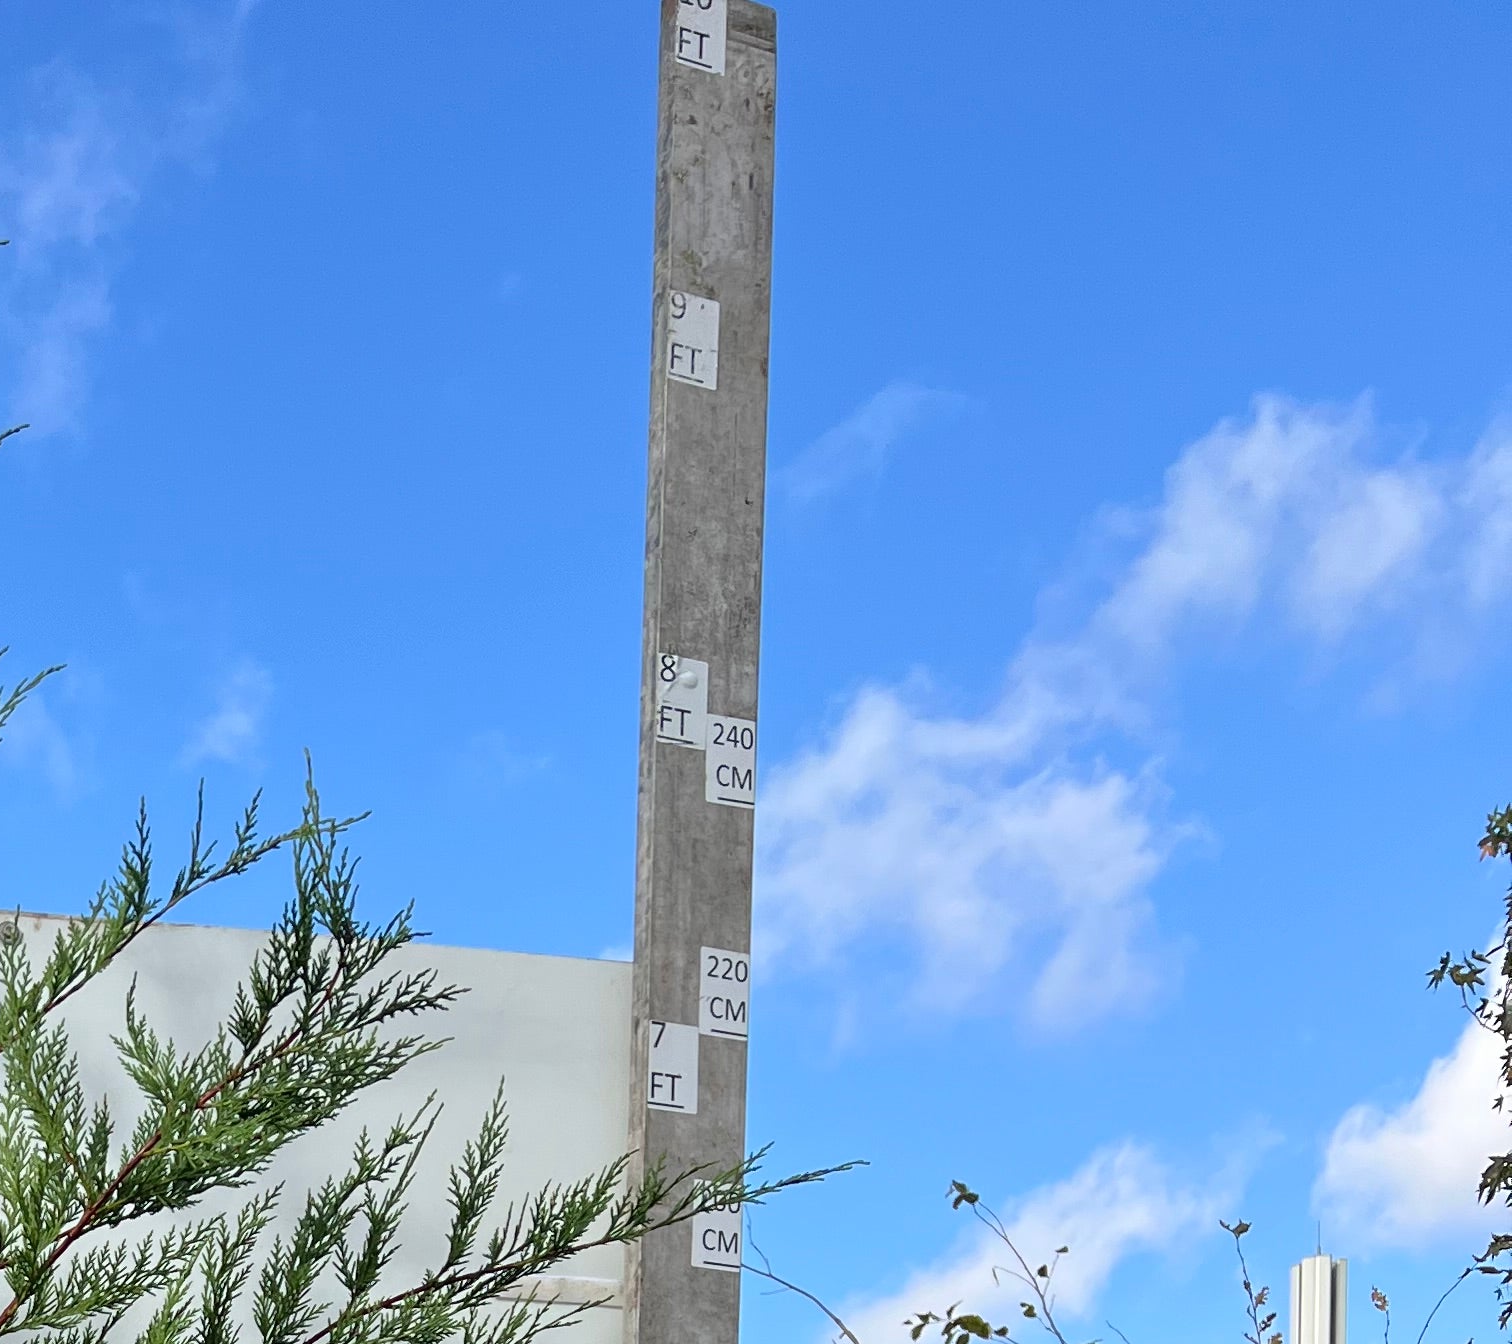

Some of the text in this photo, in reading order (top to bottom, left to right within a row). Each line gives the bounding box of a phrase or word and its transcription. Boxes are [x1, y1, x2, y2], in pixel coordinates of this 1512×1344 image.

[679, 26, 710, 59] FT
[670, 292, 687, 319] 9
[670, 343, 703, 375] FT
[660, 654, 676, 682] 8
[659, 705, 692, 737] FT
[713, 722, 754, 750] 240
[716, 764, 752, 791] CM
[707, 955, 748, 983] 220
[709, 996, 746, 1023] CM
[651, 1020, 666, 1048] 7
[650, 1071, 682, 1101] FT
[702, 1228, 738, 1254] CM
